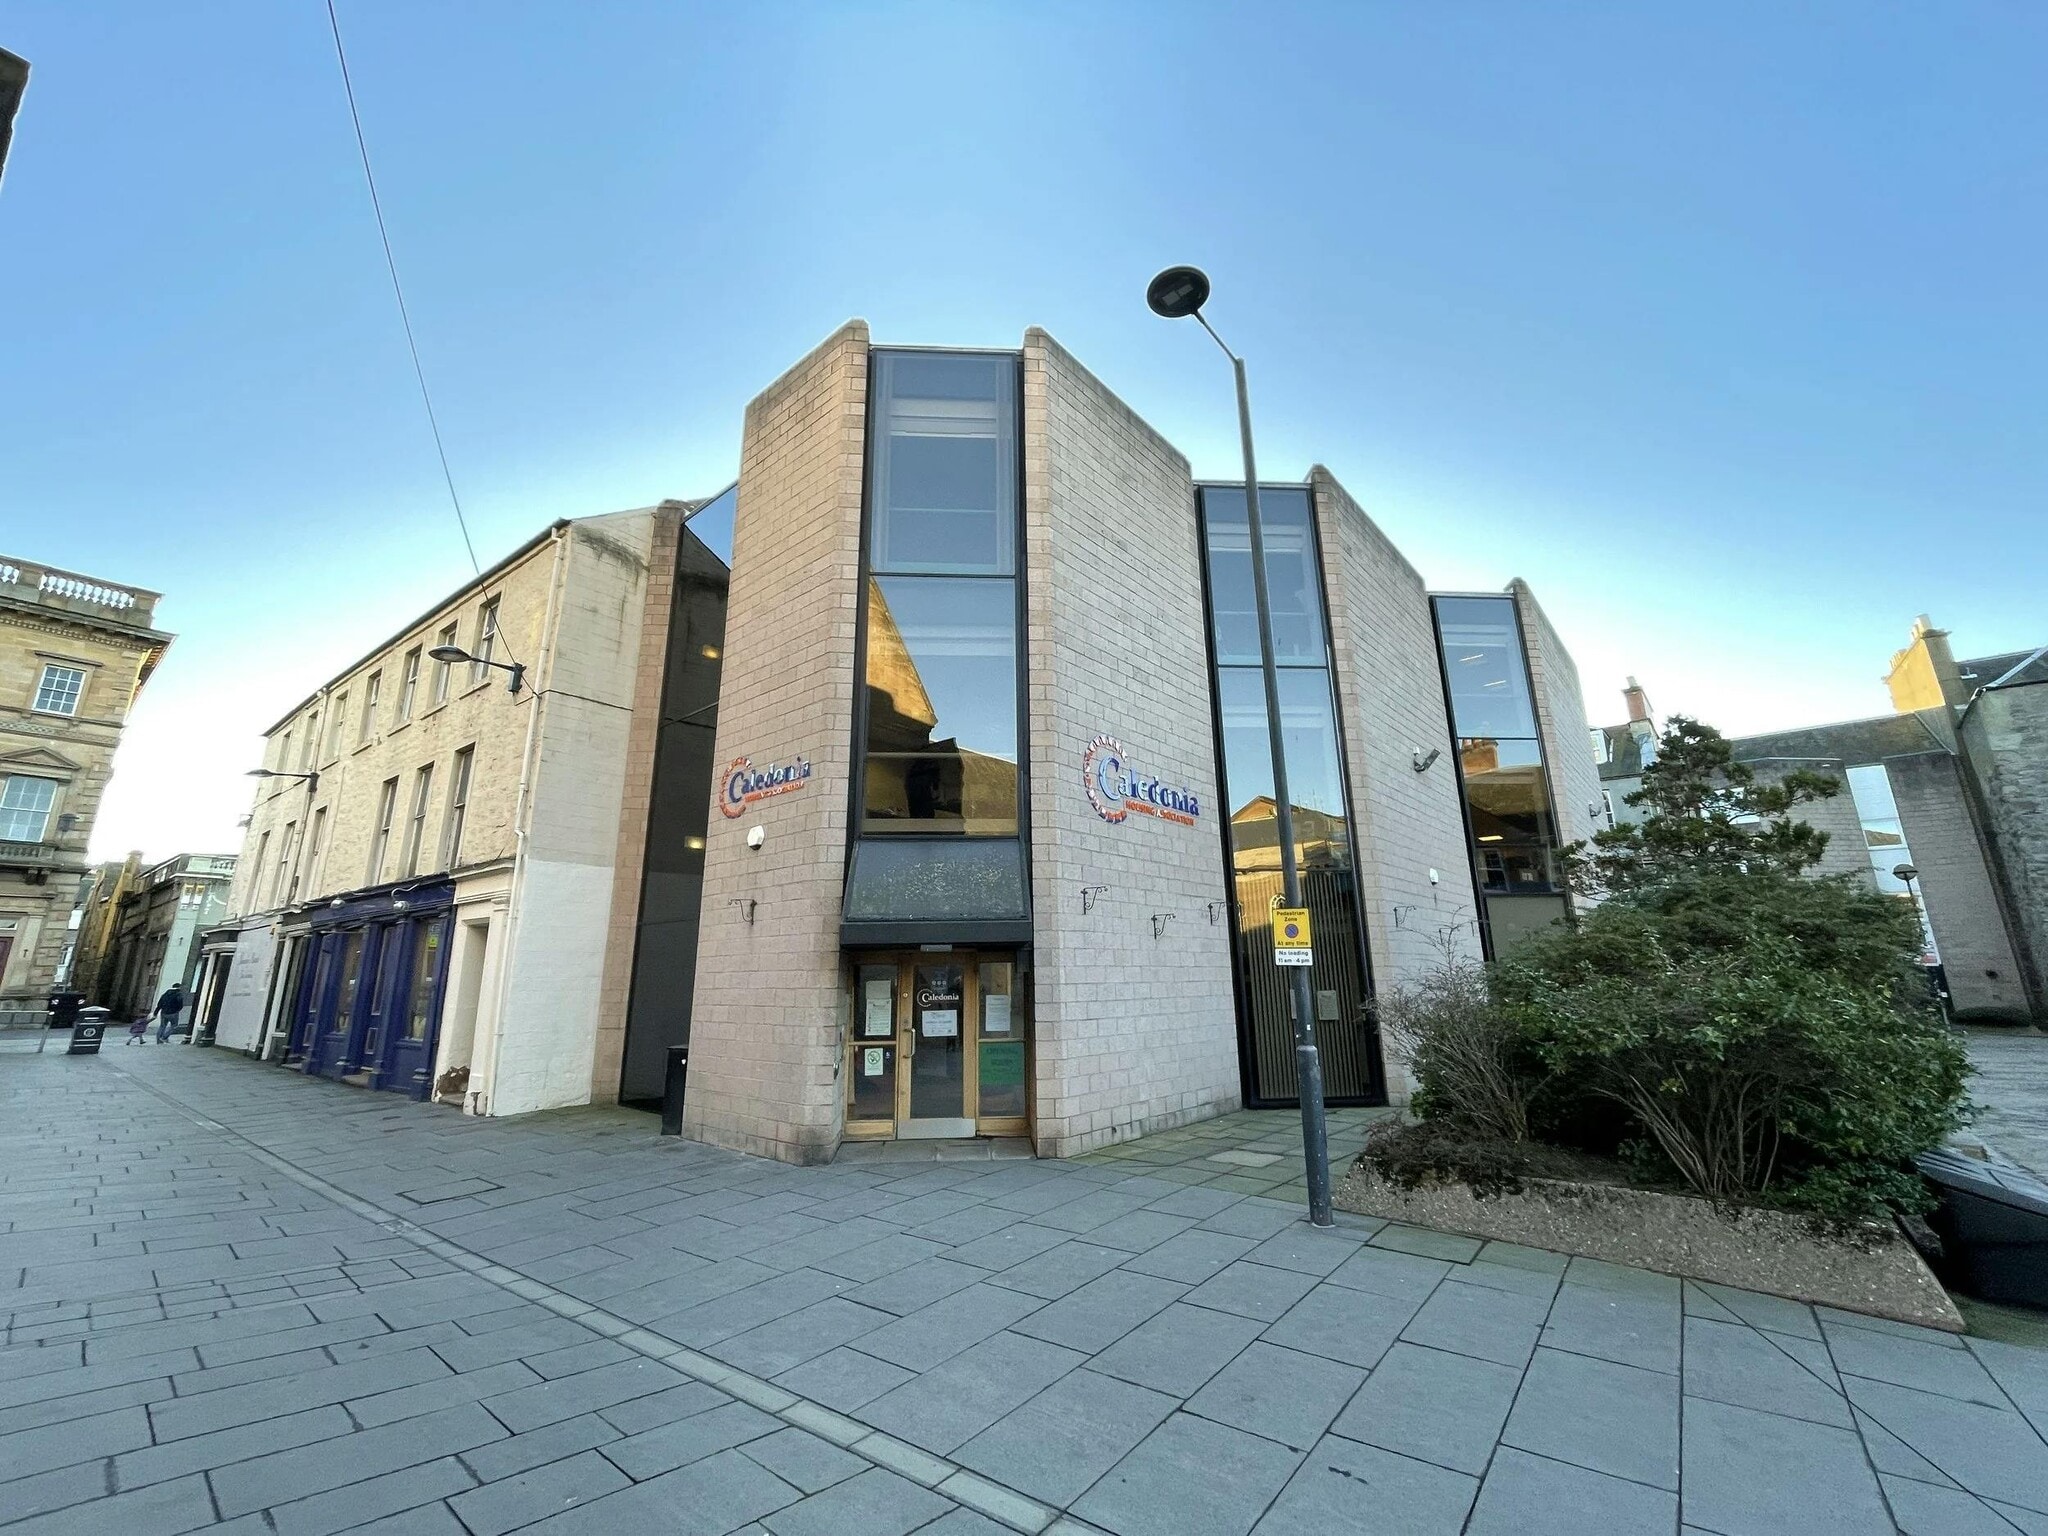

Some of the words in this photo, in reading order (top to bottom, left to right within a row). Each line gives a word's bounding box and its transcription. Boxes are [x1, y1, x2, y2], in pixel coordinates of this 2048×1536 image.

[729, 756, 811, 803] Caledonia
[1098, 757, 1199, 816] Caledonia
[922, 992, 959, 1003] Caledonia
